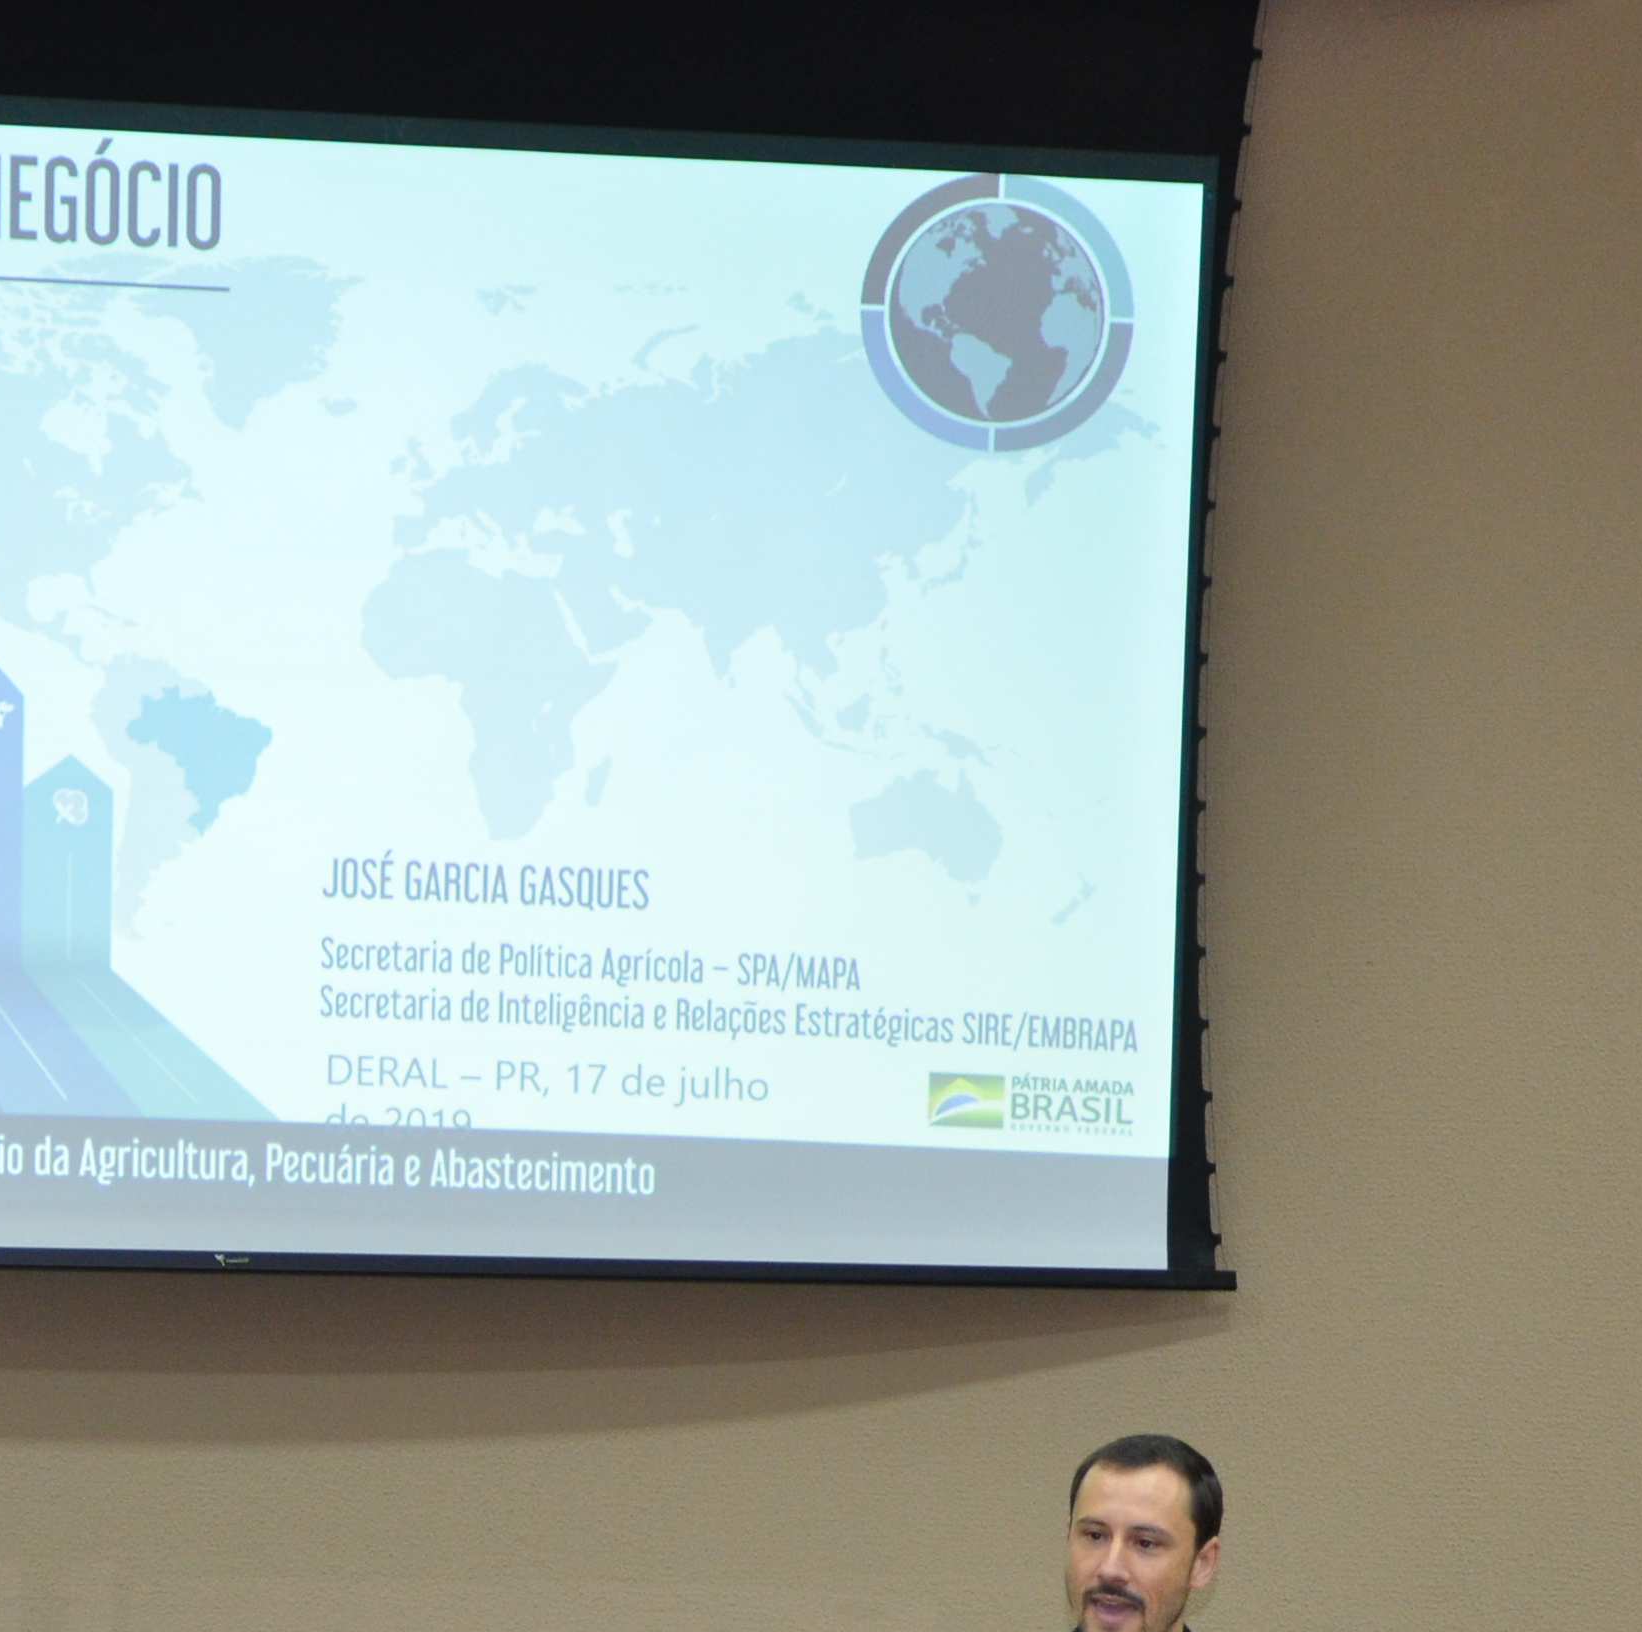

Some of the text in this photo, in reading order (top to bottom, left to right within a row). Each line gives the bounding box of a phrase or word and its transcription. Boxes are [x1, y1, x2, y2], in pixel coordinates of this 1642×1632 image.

[323, 850, 649, 911] JOSÉ GARCIA GASQUES
[321, 936, 452, 973] Secretaria
[462, 941, 490, 974] de
[500, 942, 592, 978] Política
[601, 947, 703, 988] Agrícola
[737, 952, 860, 992] SPA/MAPA
[321, 984, 1138, 1053] Secretaria de Inteligência e Relações Estratégicas SIRE/EMBRAPA
[327, 1054, 447, 1088] DERAL
[496, 1060, 549, 1097] PR,
[568, 1063, 607, 1095] 17
[621, 1063, 665, 1097] de
[673, 1066, 769, 1108] julho
[1012, 1073, 1134, 1096] PÁTRIA AMADA
[1011, 1093, 1133, 1125] BRASIL
[1011, 1124, 1069, 1133] GOVERNO
[35, 1136, 69, 1176] da
[79, 1138, 255, 1186] Agricultura,
[266, 1142, 394, 1185] Pecuária
[405, 1155, 420, 1187] e
[430, 1148, 654, 1195] Abastecimento
